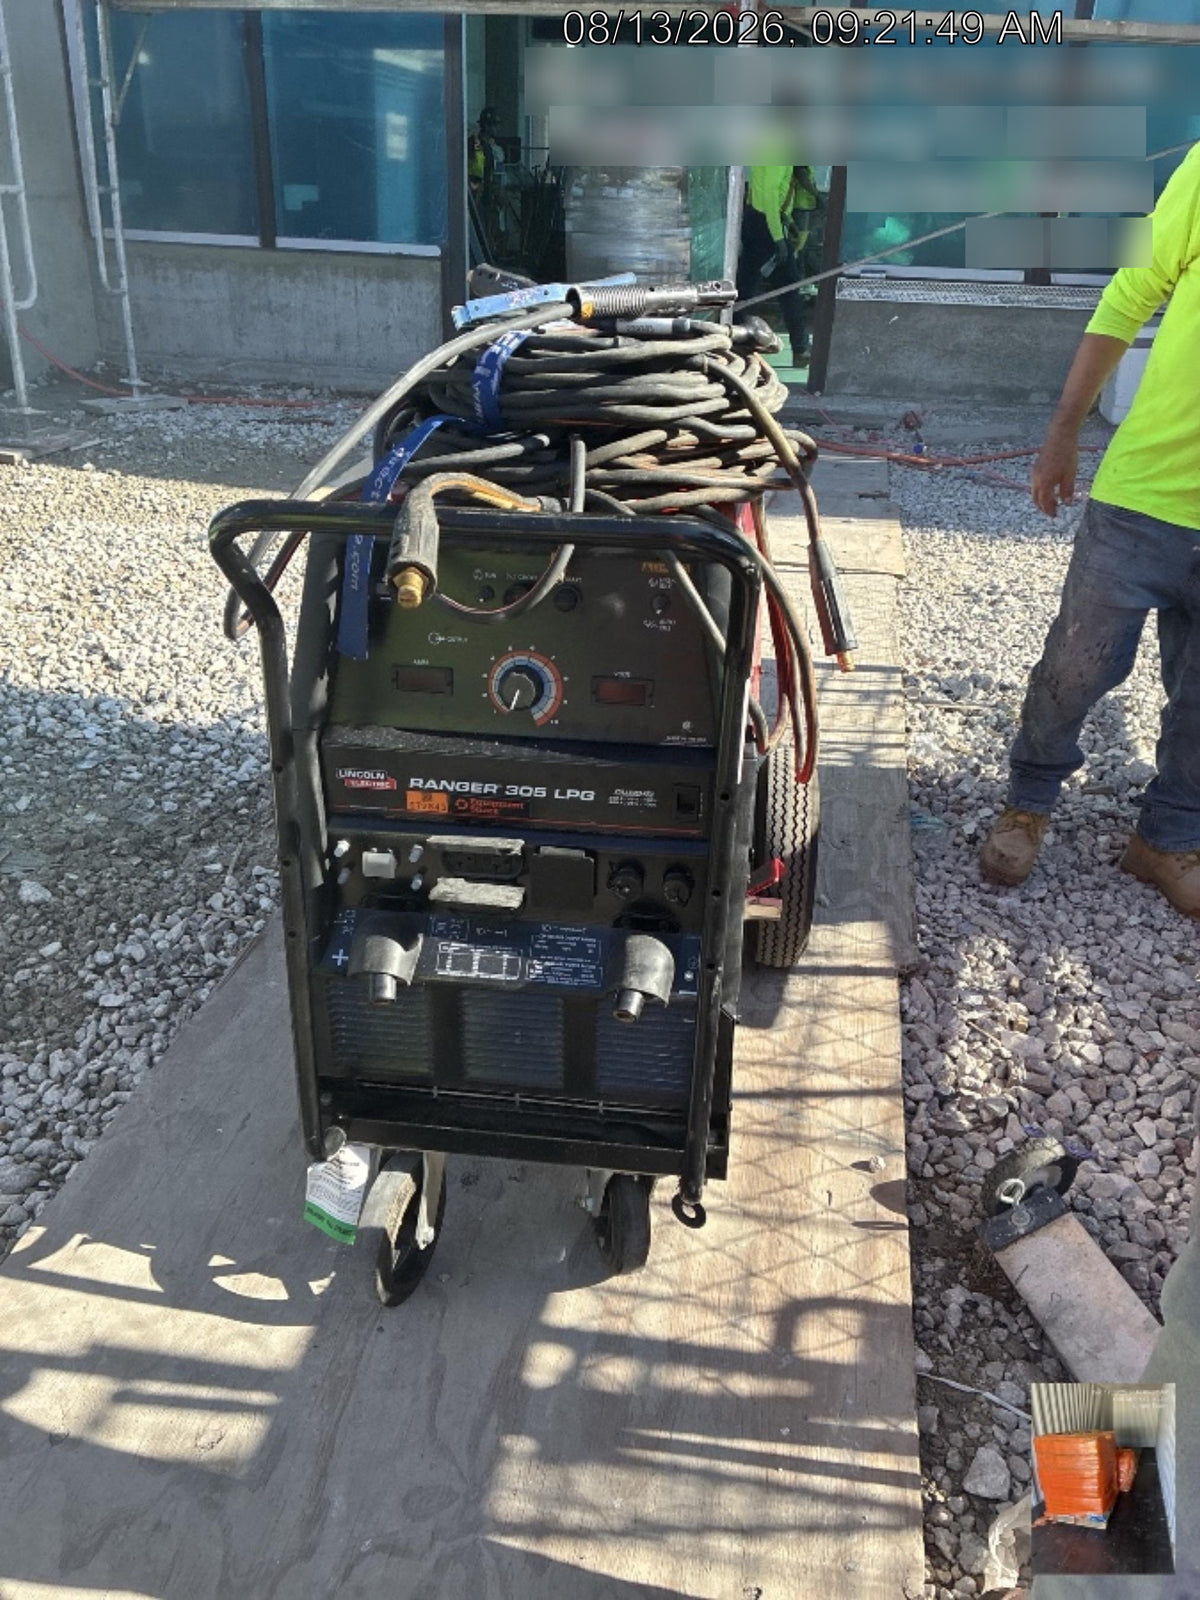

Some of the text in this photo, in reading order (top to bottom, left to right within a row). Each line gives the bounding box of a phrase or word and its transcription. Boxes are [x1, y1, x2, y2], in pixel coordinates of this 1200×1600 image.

[338, 768, 385, 780] LINCOLN
[409, 777, 498, 795] RANGER
[505, 784, 547, 798] 305
[554, 788, 596, 801] LPG
[470, 797, 524, 809] Equipment
